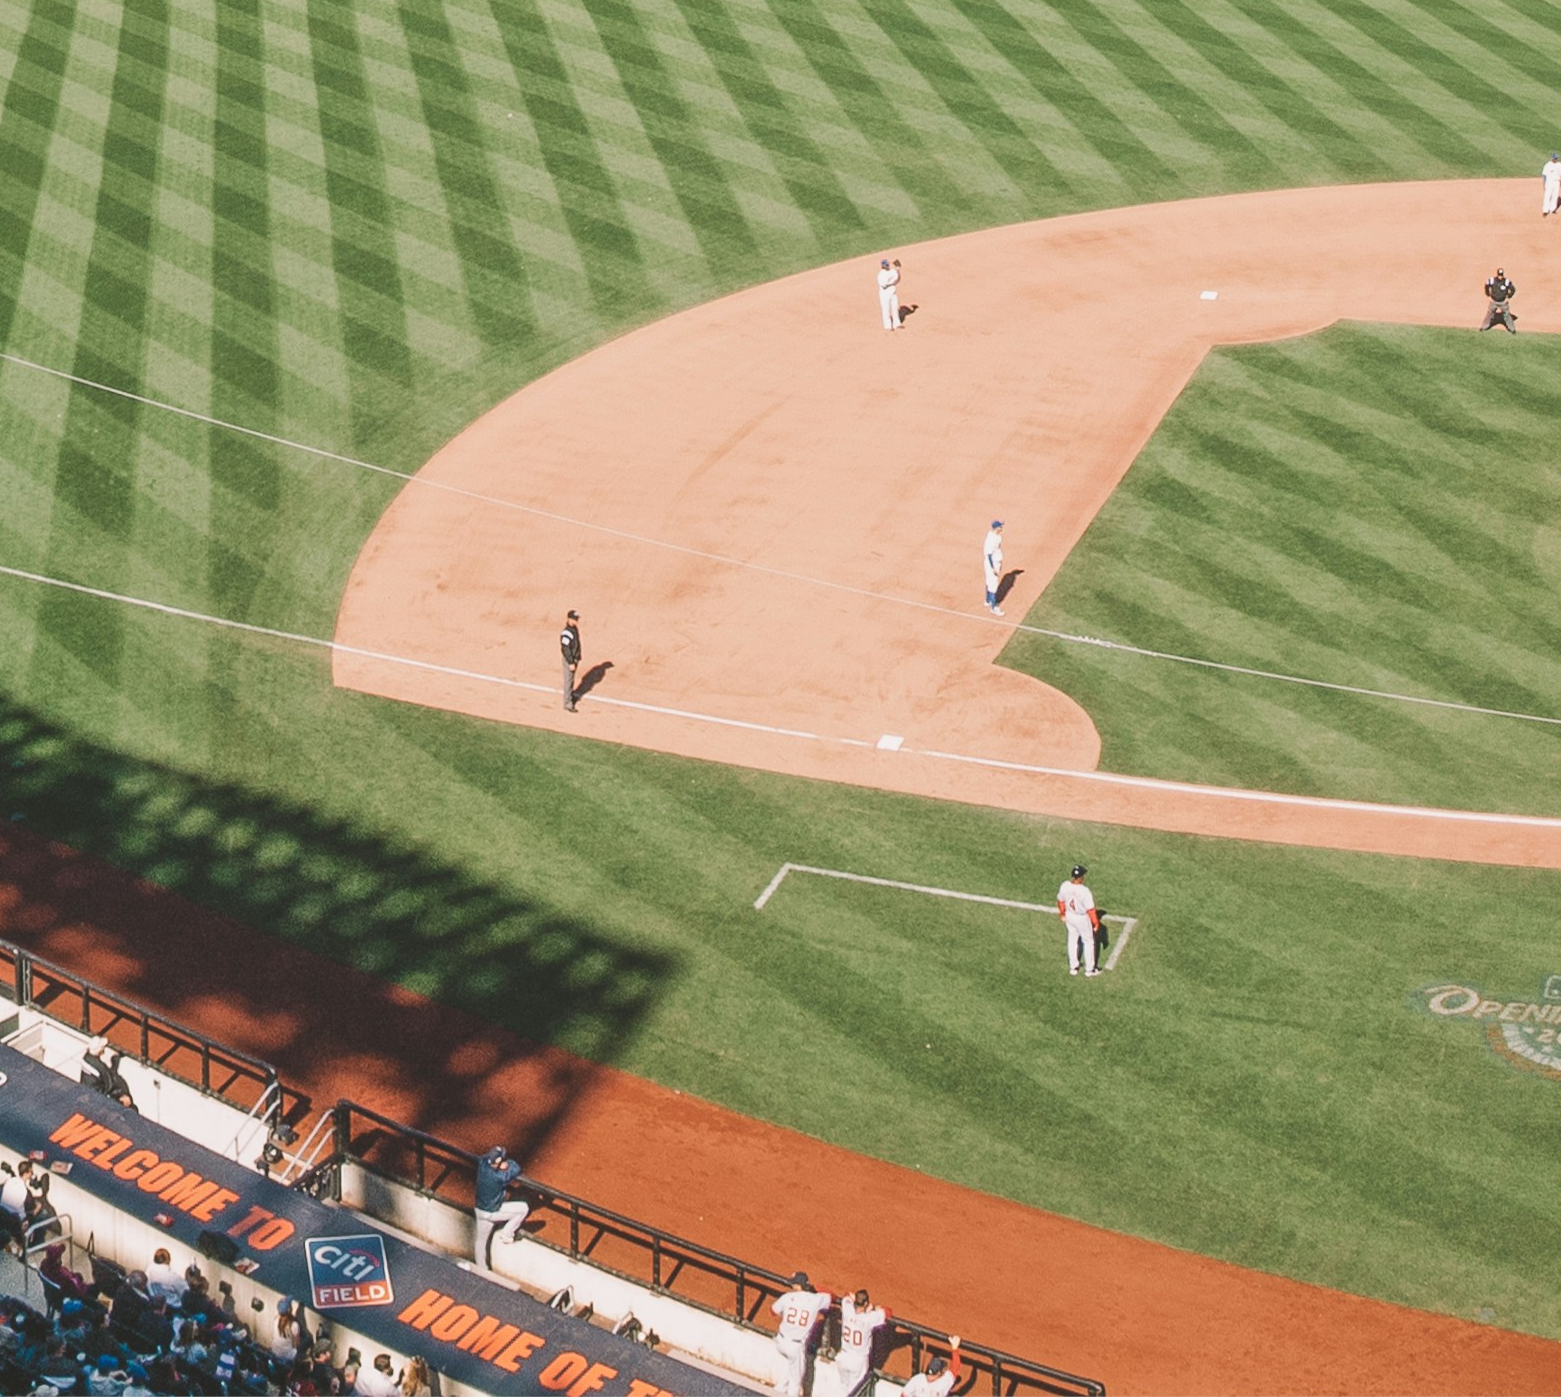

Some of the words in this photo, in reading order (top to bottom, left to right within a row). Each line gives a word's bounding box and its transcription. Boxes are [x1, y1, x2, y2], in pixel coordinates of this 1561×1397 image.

[47, 1111, 241, 1224] WELCOME
[226, 1203, 296, 1253] TO
[312, 1243, 377, 1284] citi
[318, 1283, 387, 1305] FIELD
[786, 1305, 810, 1327] 28
[397, 1288, 546, 1374] HOME
[538, 1351, 620, 1396] OF
[841, 1326, 862, 1346] 20
